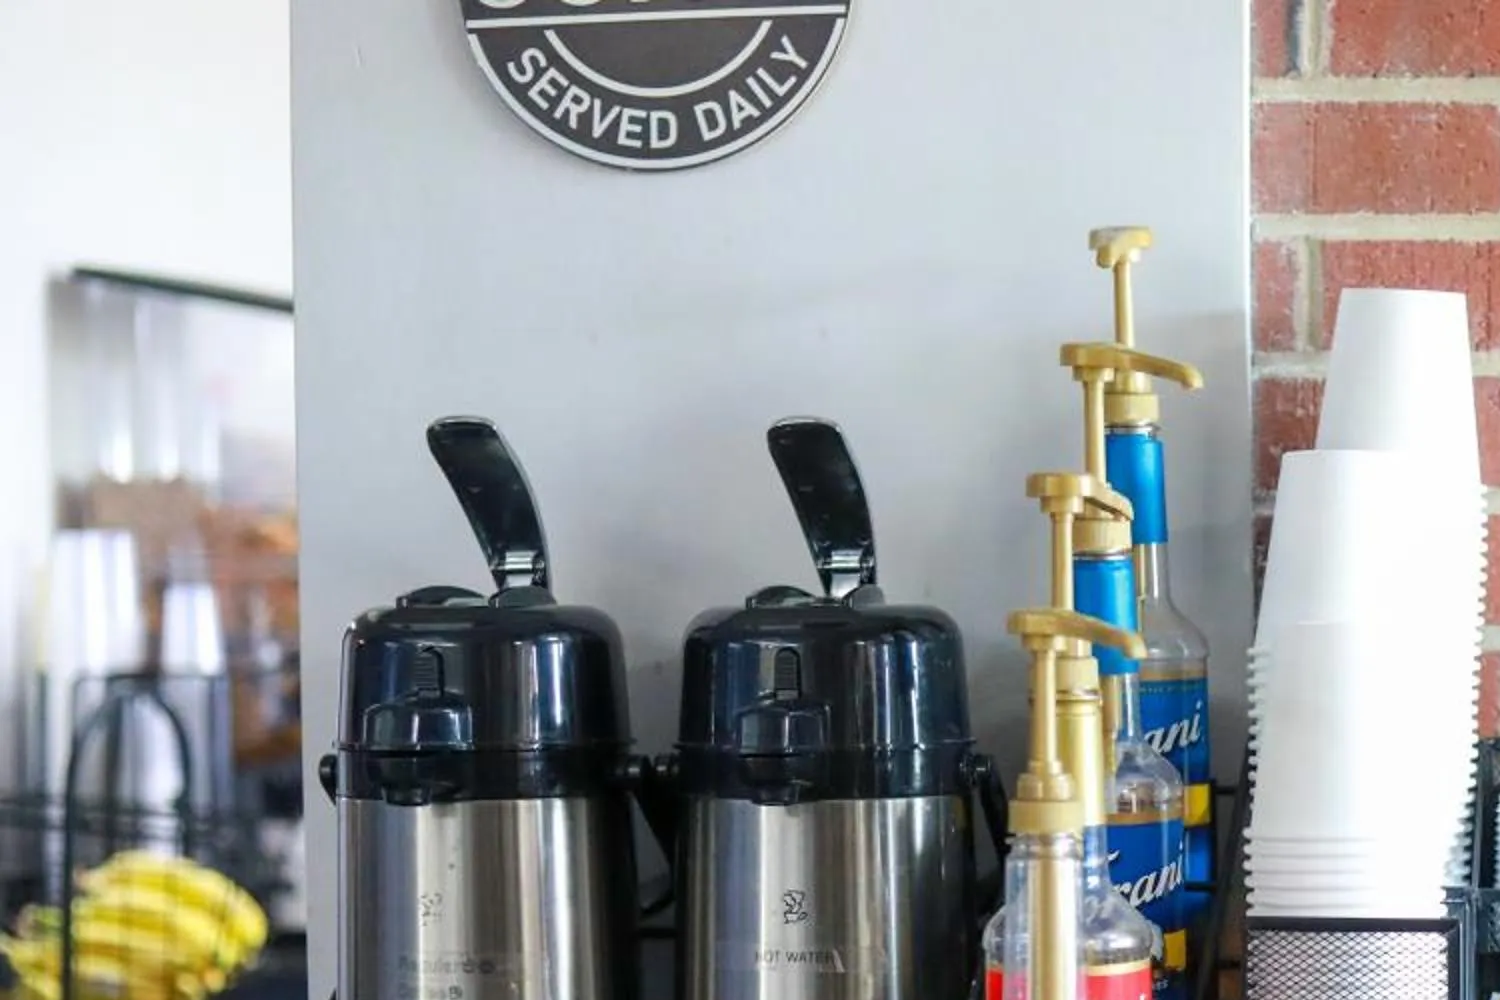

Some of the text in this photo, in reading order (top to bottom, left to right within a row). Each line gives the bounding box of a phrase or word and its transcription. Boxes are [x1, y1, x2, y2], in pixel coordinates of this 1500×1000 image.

[507, 35, 809, 149] SERVED DAILY
[1144, 701, 1204, 753] ani
